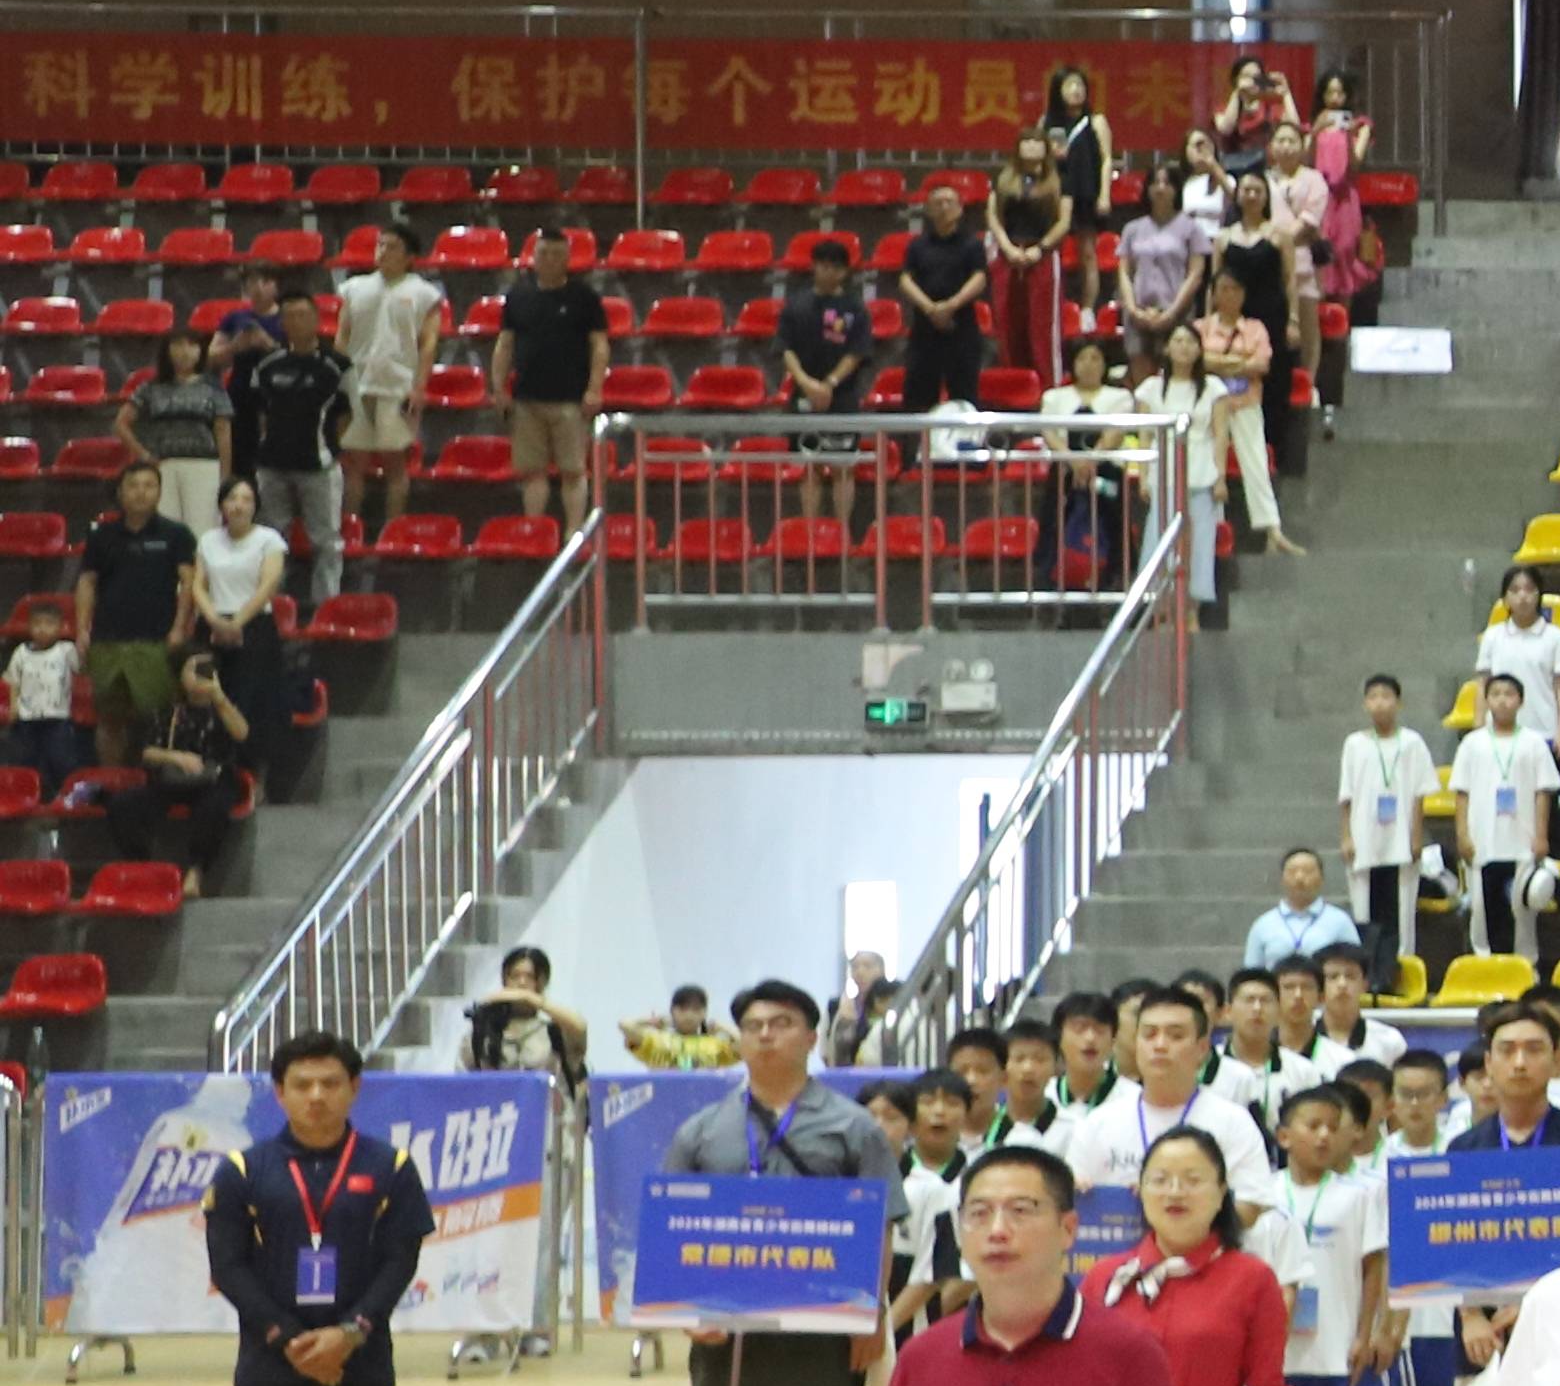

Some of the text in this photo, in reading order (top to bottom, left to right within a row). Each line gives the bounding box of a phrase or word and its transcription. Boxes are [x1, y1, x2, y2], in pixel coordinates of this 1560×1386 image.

[23, 50, 1232, 125] 科学训练，保护每个运动员未
